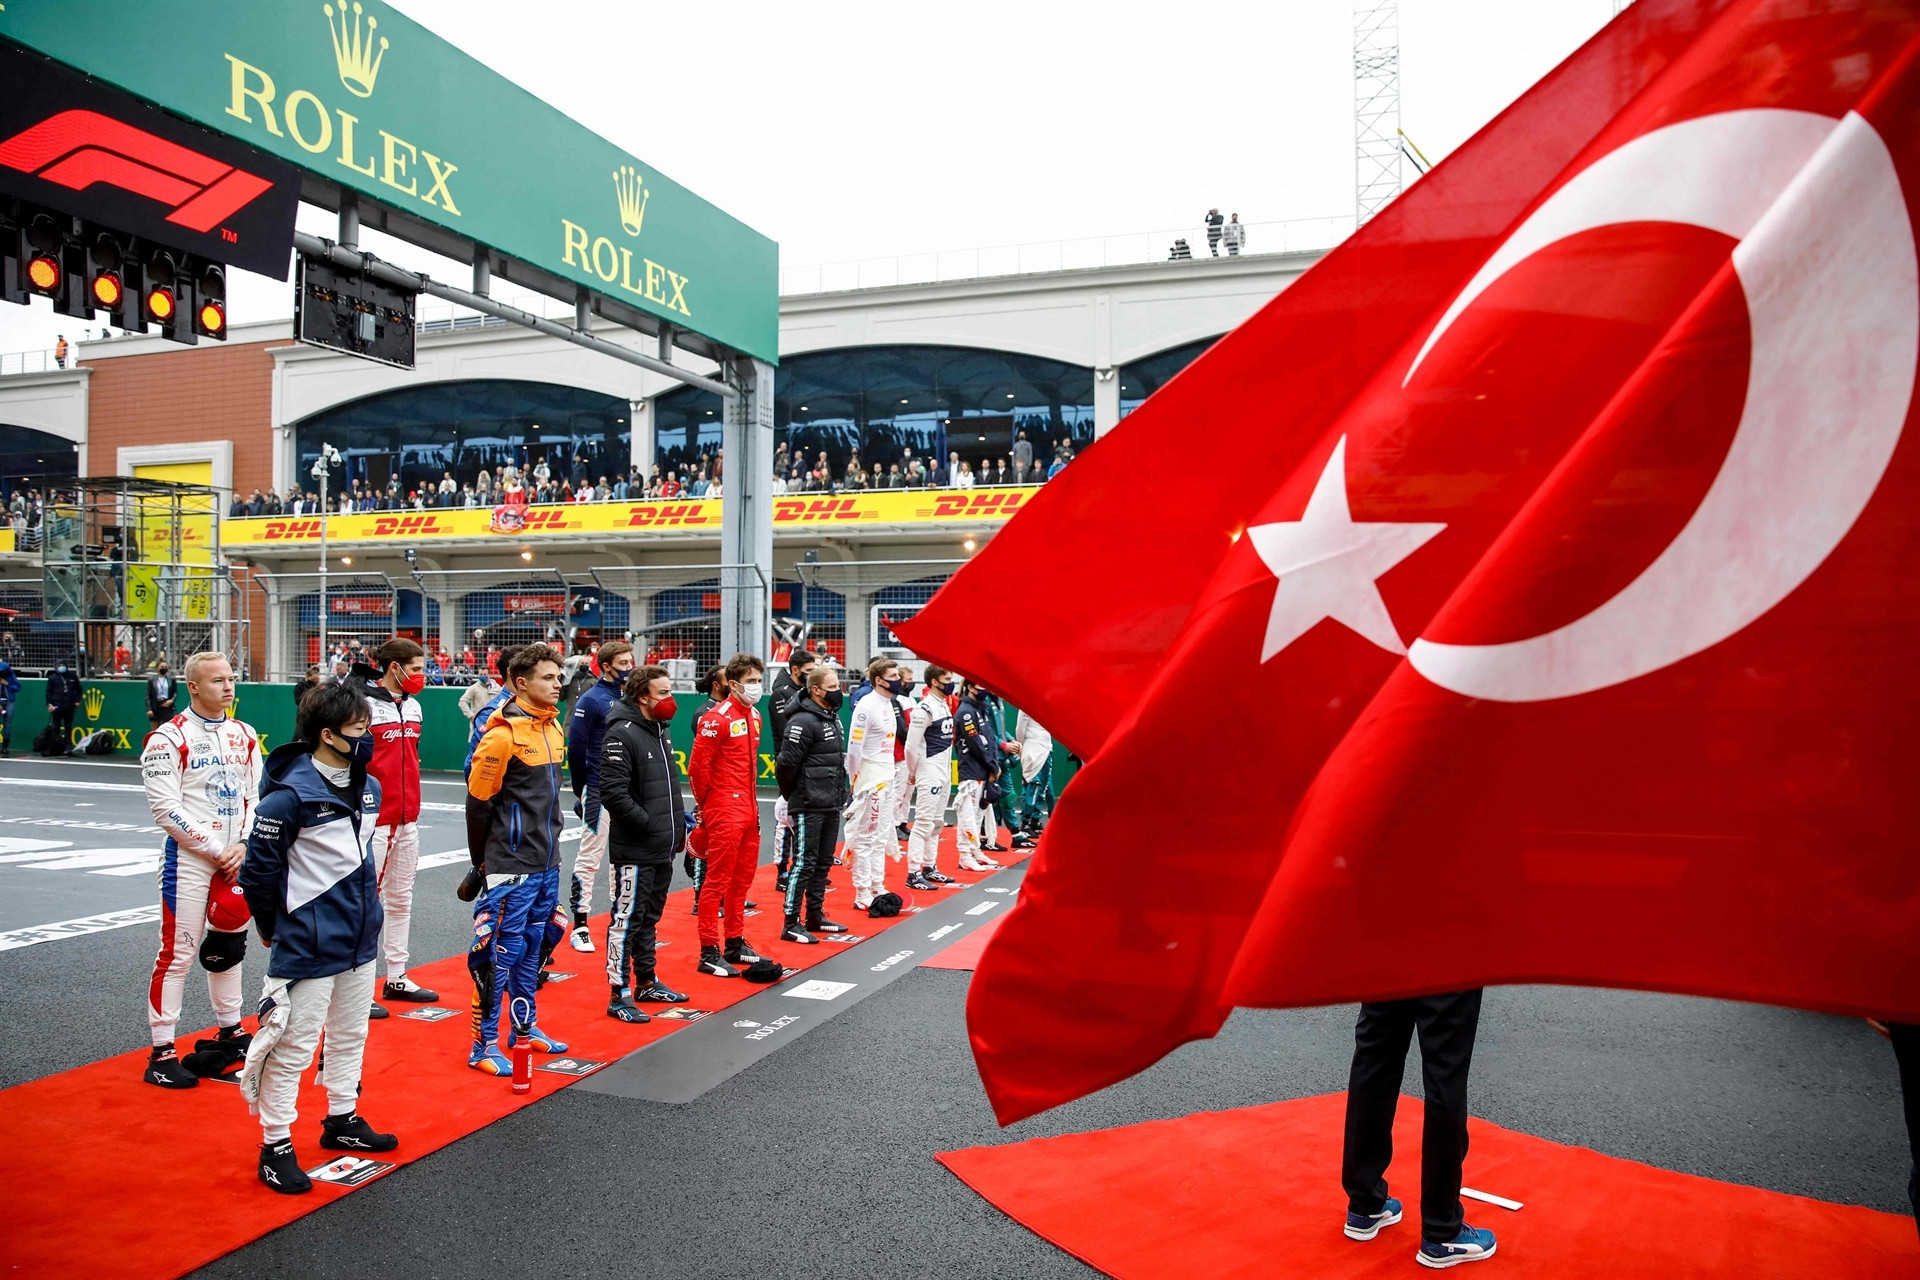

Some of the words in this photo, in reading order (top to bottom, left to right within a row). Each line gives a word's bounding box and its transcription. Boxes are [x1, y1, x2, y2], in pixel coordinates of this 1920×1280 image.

[224, 52, 462, 217] ROLEX
[561, 218, 692, 317] ROLEX
[524, 510, 569, 530] HL
[628, 505, 708, 526] DHL
[773, 499, 862, 521] DHL
[264, 521, 323, 539] DHL
[375, 516, 441, 535] DHL
[217, 807, 239, 816] MSU
[613, 866, 632, 928] LPINE
[744, 1015, 801, 1040] ROLEX
